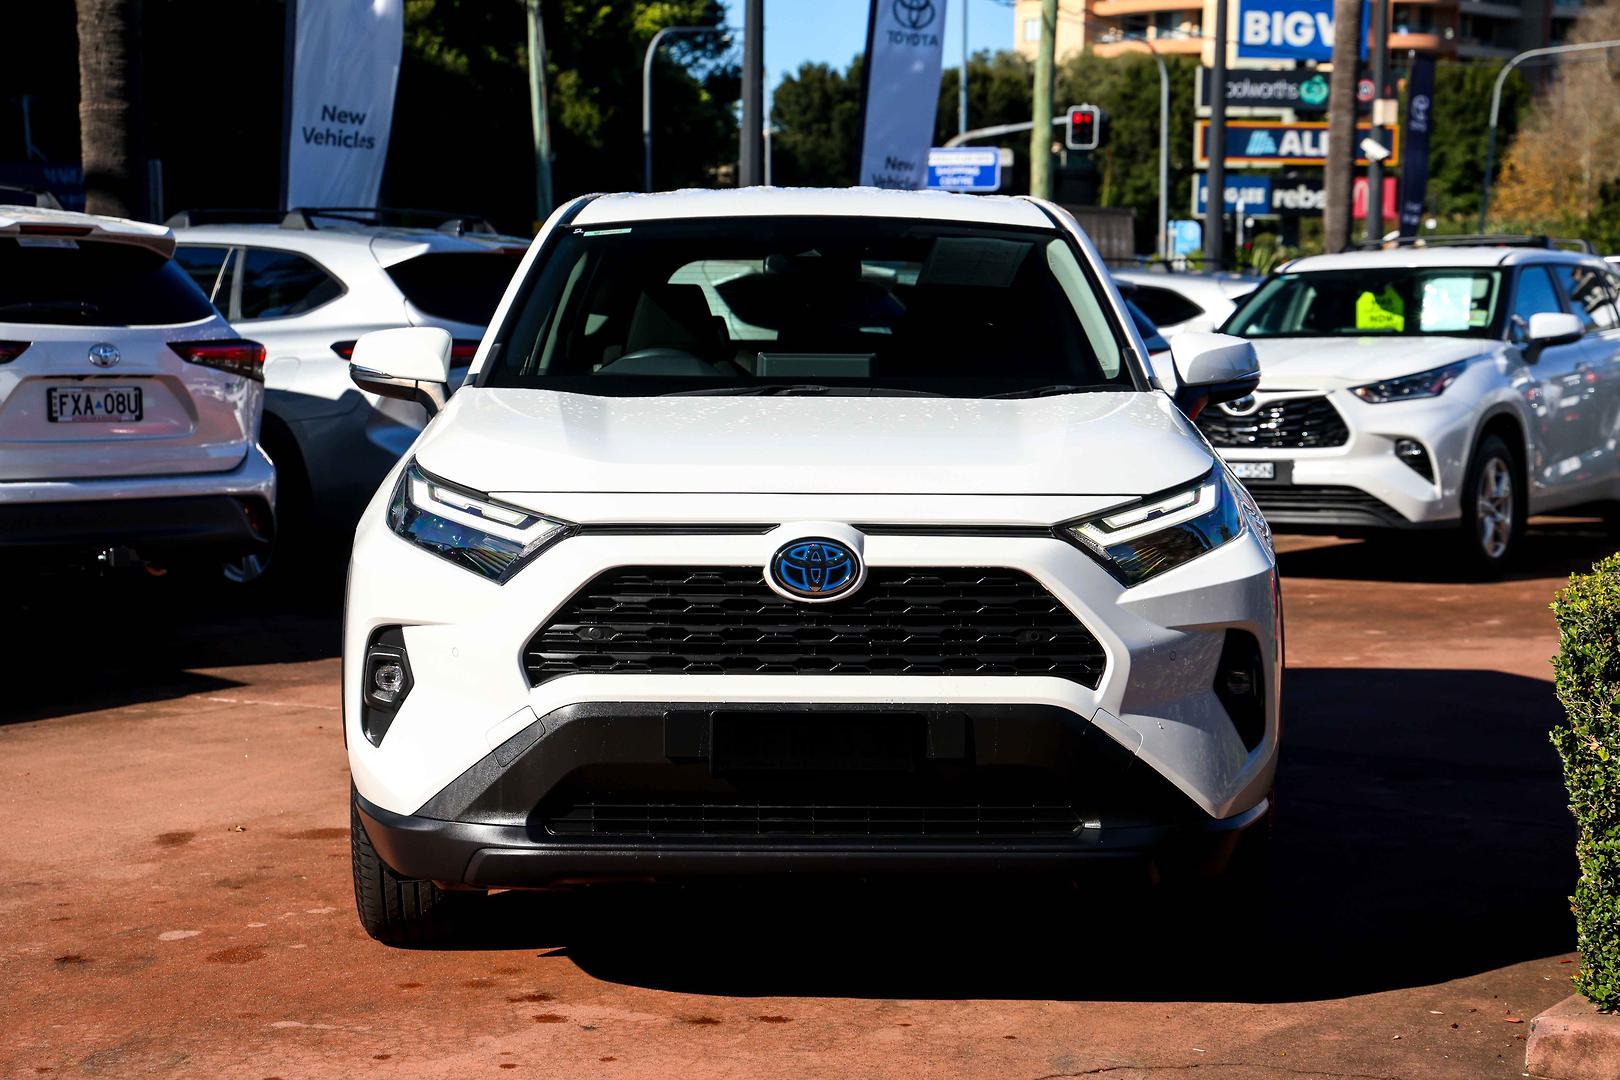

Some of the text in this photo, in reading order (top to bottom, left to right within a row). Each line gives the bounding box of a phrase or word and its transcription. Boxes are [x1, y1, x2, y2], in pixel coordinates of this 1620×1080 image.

[887, 31, 939, 46] TOYOTA
[1225, 79, 1298, 99] oolworths
[322, 105, 366, 125] New
[303, 127, 376, 149] Vehicles
[1278, 130, 1329, 156] AL
[885, 156, 915, 171] New
[59, 394, 95, 416] FXA
